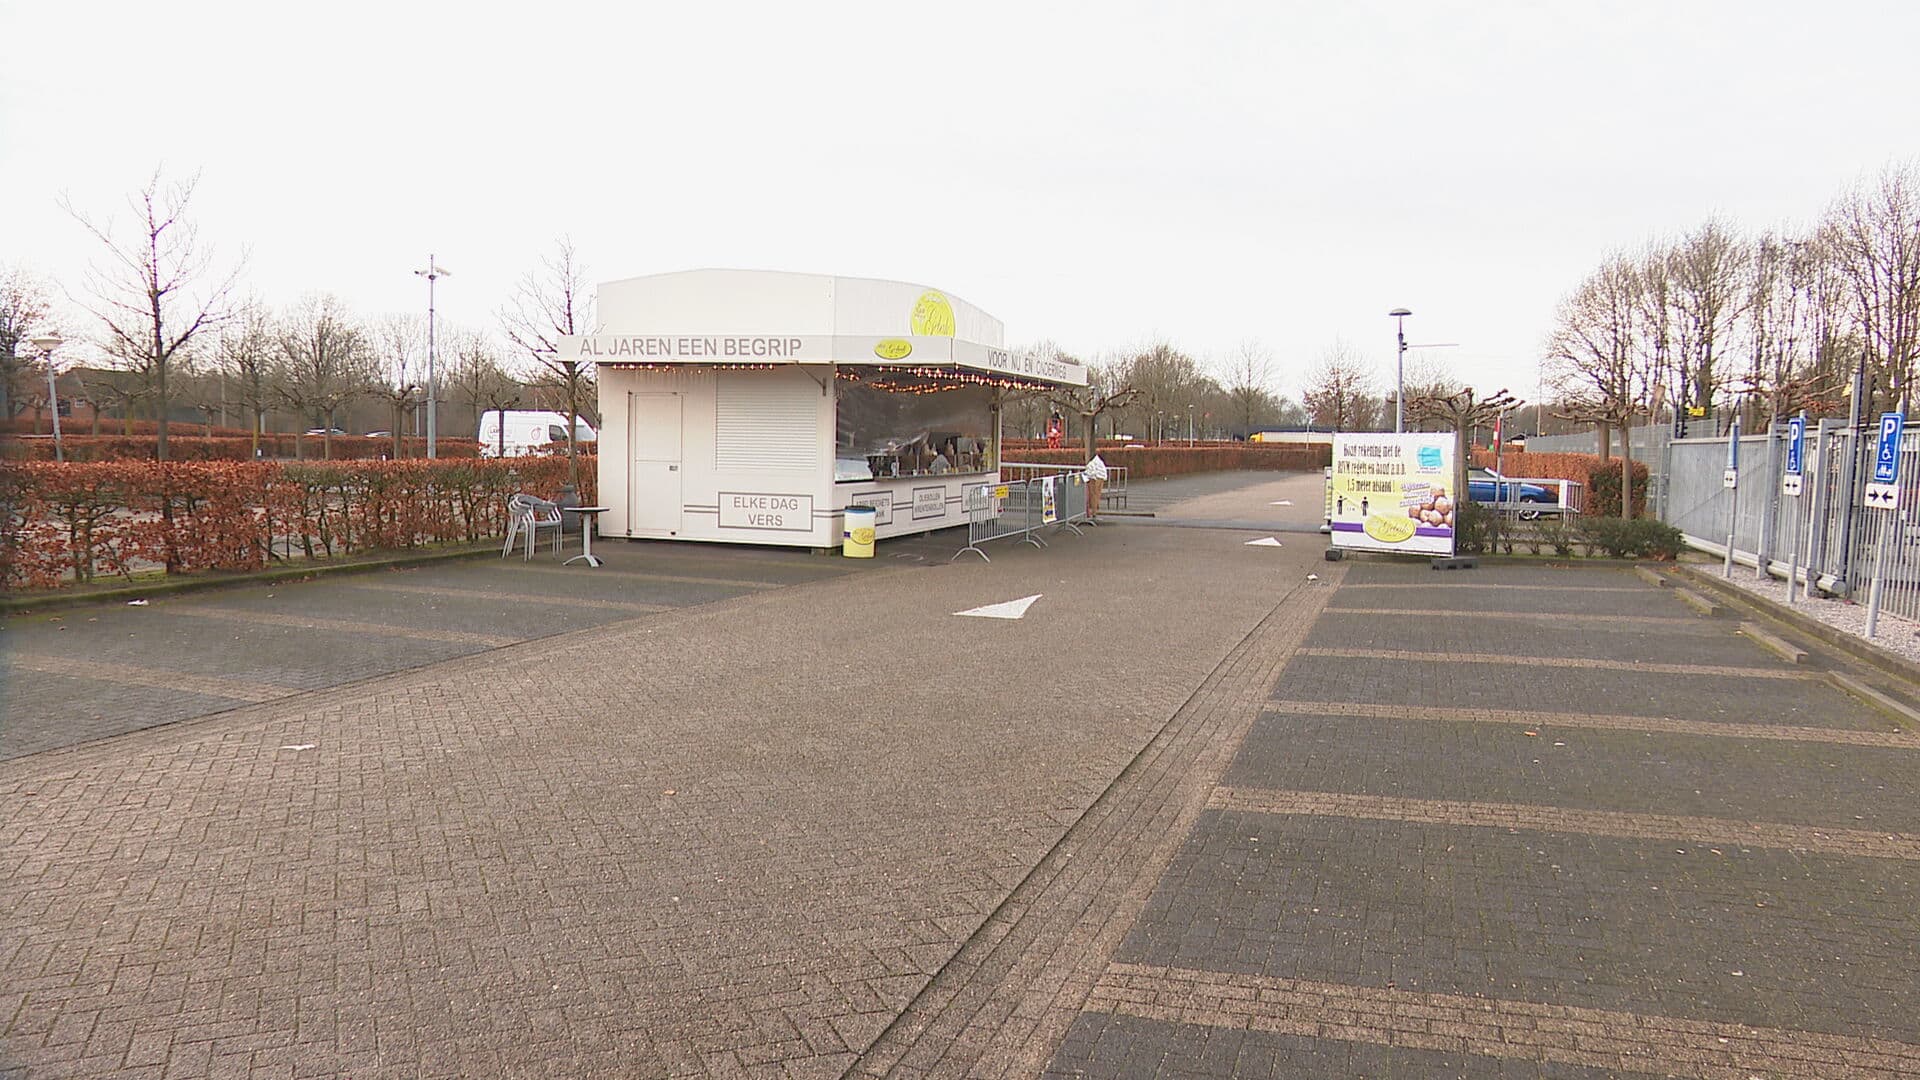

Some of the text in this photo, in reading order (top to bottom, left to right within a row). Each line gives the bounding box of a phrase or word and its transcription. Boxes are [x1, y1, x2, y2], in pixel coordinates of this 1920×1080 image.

[580, 338, 802, 357] AL JAREN EEN BEGRIP
[988, 349, 1007, 369] VOOR
[1025, 357, 1033, 374] EN
[1791, 423, 1799, 451] P
[1883, 419, 1896, 442] P
[733, 496, 799, 510] ELKE DAG
[748, 513, 784, 527] VERS
